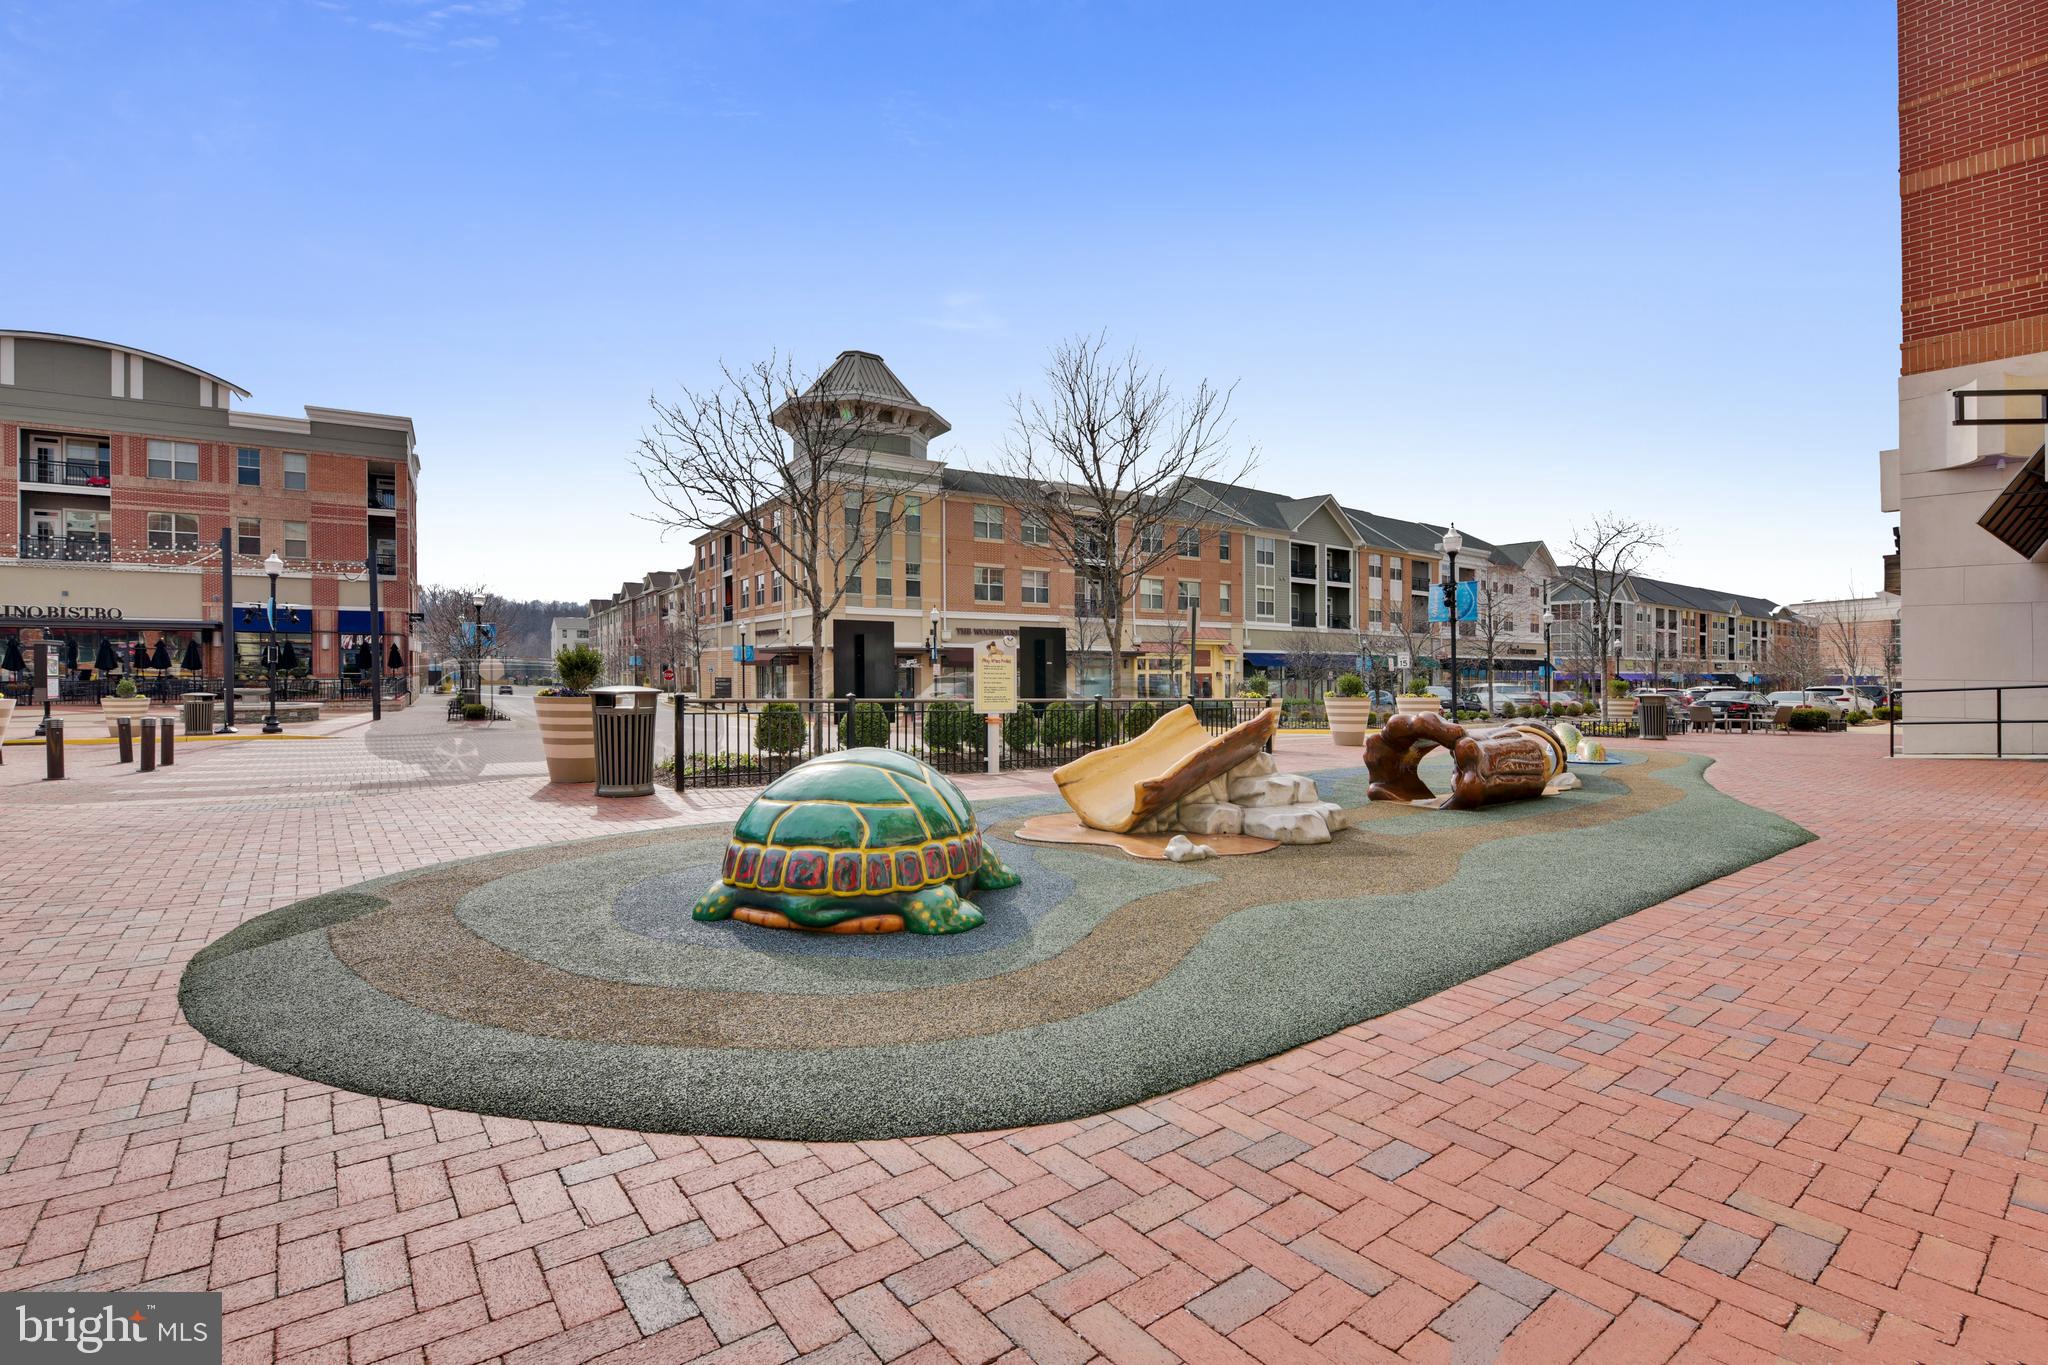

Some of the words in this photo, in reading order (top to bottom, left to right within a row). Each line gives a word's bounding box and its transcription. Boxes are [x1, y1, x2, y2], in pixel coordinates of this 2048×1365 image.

[0, 605, 43, 619] INO
[47, 606, 123, 620] BISTRO
[956, 627, 971, 636] THE
